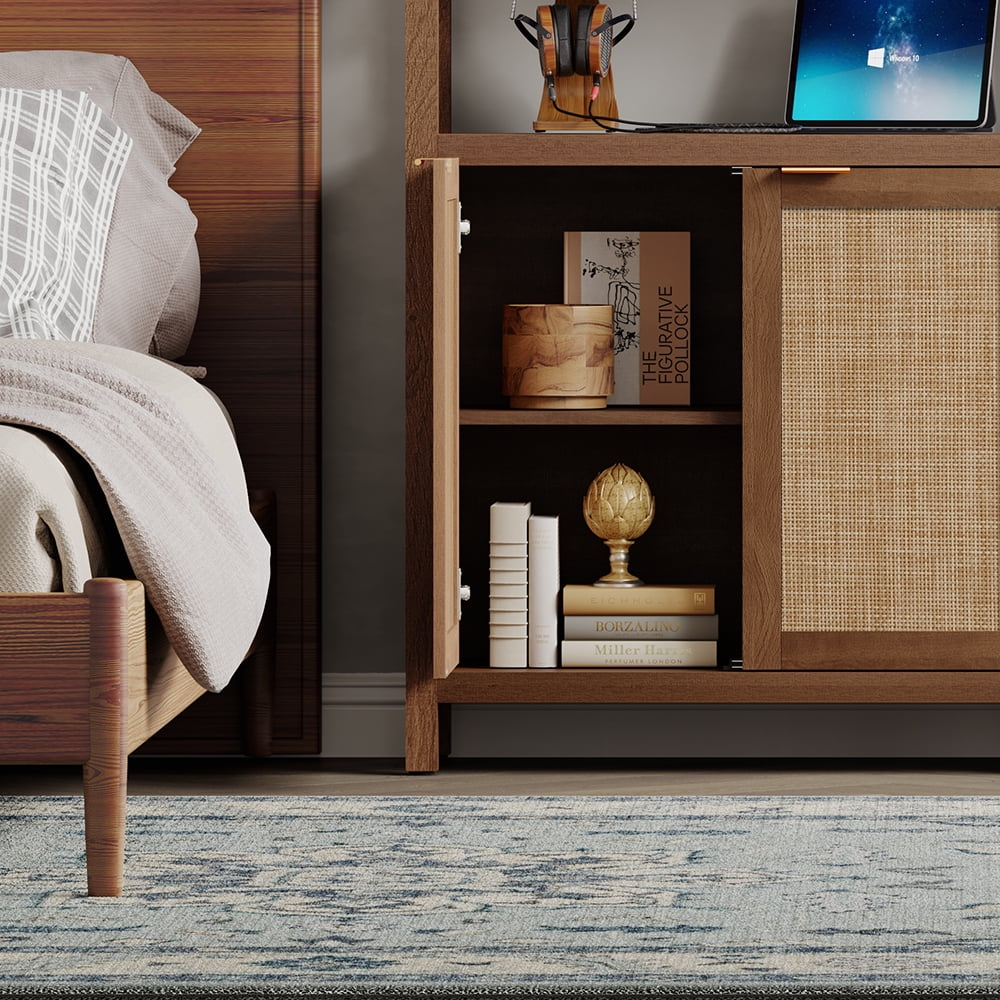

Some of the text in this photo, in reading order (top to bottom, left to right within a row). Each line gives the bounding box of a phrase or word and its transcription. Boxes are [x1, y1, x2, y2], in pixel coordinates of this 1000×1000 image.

[912, 54, 920, 62] 10
[658, 286, 673, 384] FIGURATIVE
[674, 303, 689, 384] POLLOCK
[642, 351, 656, 385] THE
[595, 621, 681, 633] BORZALINO
[595, 644, 640, 656] Miller
